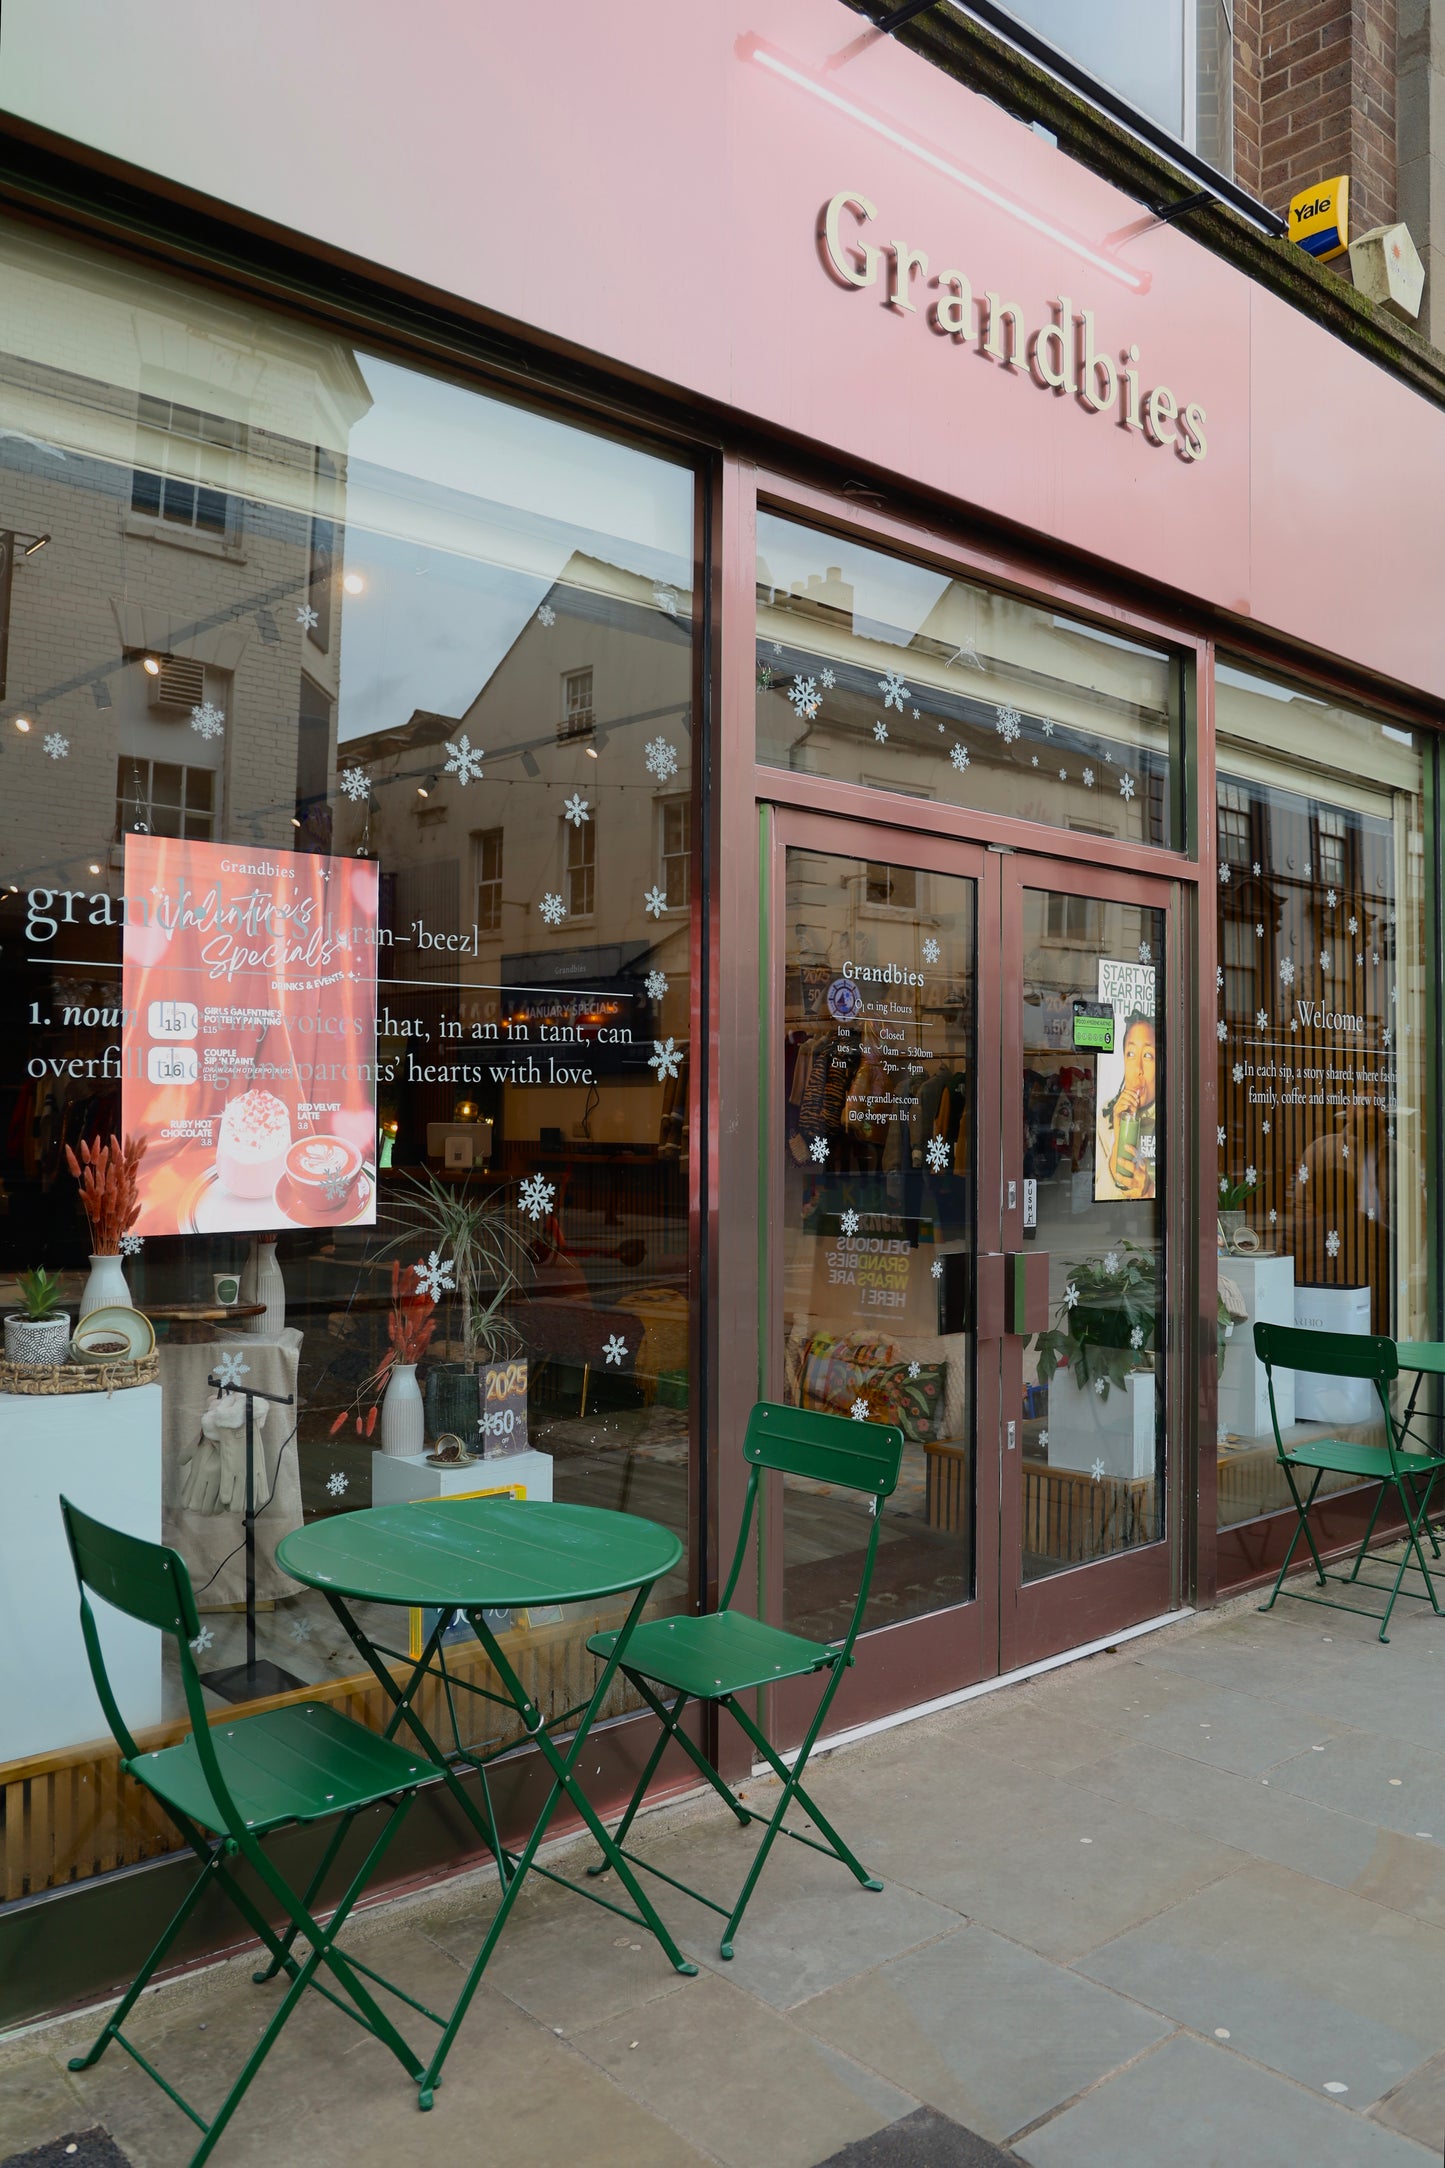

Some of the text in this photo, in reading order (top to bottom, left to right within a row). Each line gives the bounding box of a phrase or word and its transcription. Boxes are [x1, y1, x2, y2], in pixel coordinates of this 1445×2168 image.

[1294, 198, 1331, 223] Yale
[822, 190, 1208, 461] Grandbies
[220, 859, 295, 879] Grandbies
[201, 926, 346, 983] Specials
[271, 971, 345, 991] DRINKS & EVENTS
[842, 961, 925, 987] Grandbies
[1103, 964, 1140, 983] START
[1103, 980, 1133, 999] YEAR
[203, 1007, 229, 1016] GIRLS
[572, 1001, 619, 1017] SPECIALS
[890, 1001, 913, 1014] Hours
[1296, 999, 1364, 1032] Welcome
[29, 1002, 51, 1026] 1.
[63, 1005, 138, 1028] noun
[373, 1007, 431, 1042] that,
[439, 1013, 464, 1039] in
[471, 1020, 499, 1041] an
[597, 1026, 633, 1045] can
[879, 1028, 905, 1041] Closed
[203, 1049, 237, 1058] COUPLE
[203, 1057, 218, 1065] SIP
[229, 1057, 254, 1066] PAINT
[407, 1052, 482, 1083] hearts
[488, 1055, 542, 1084] with
[549, 1056, 598, 1085] love.
[907, 1062, 924, 1076] 4pm
[1244, 1060, 1255, 1077] In
[1256, 1060, 1277, 1077] each
[1279, 1064, 1295, 1084] sip,
[1296, 1069, 1302, 1079] a
[1303, 1066, 1325, 1085] story
[1356, 1065, 1379, 1082] where
[297, 1103, 341, 1112] RED VELVET
[1248, 1086, 1280, 1110] family,
[1281, 1088, 1307, 1105] coffee
[1308, 1089, 1325, 1105] and
[1326, 1089, 1351, 1106] smiles
[1352, 1089, 1372, 1106] brew
[170, 1119, 213, 1129] RUBY HOT
[297, 1112, 320, 1121] LATTE
[297, 1121, 309, 1130] 3.8
[160, 1128, 213, 1138] CHOCOLATE
[201, 1138, 213, 1146] 3.8
[485, 1363, 528, 1402] 2025
